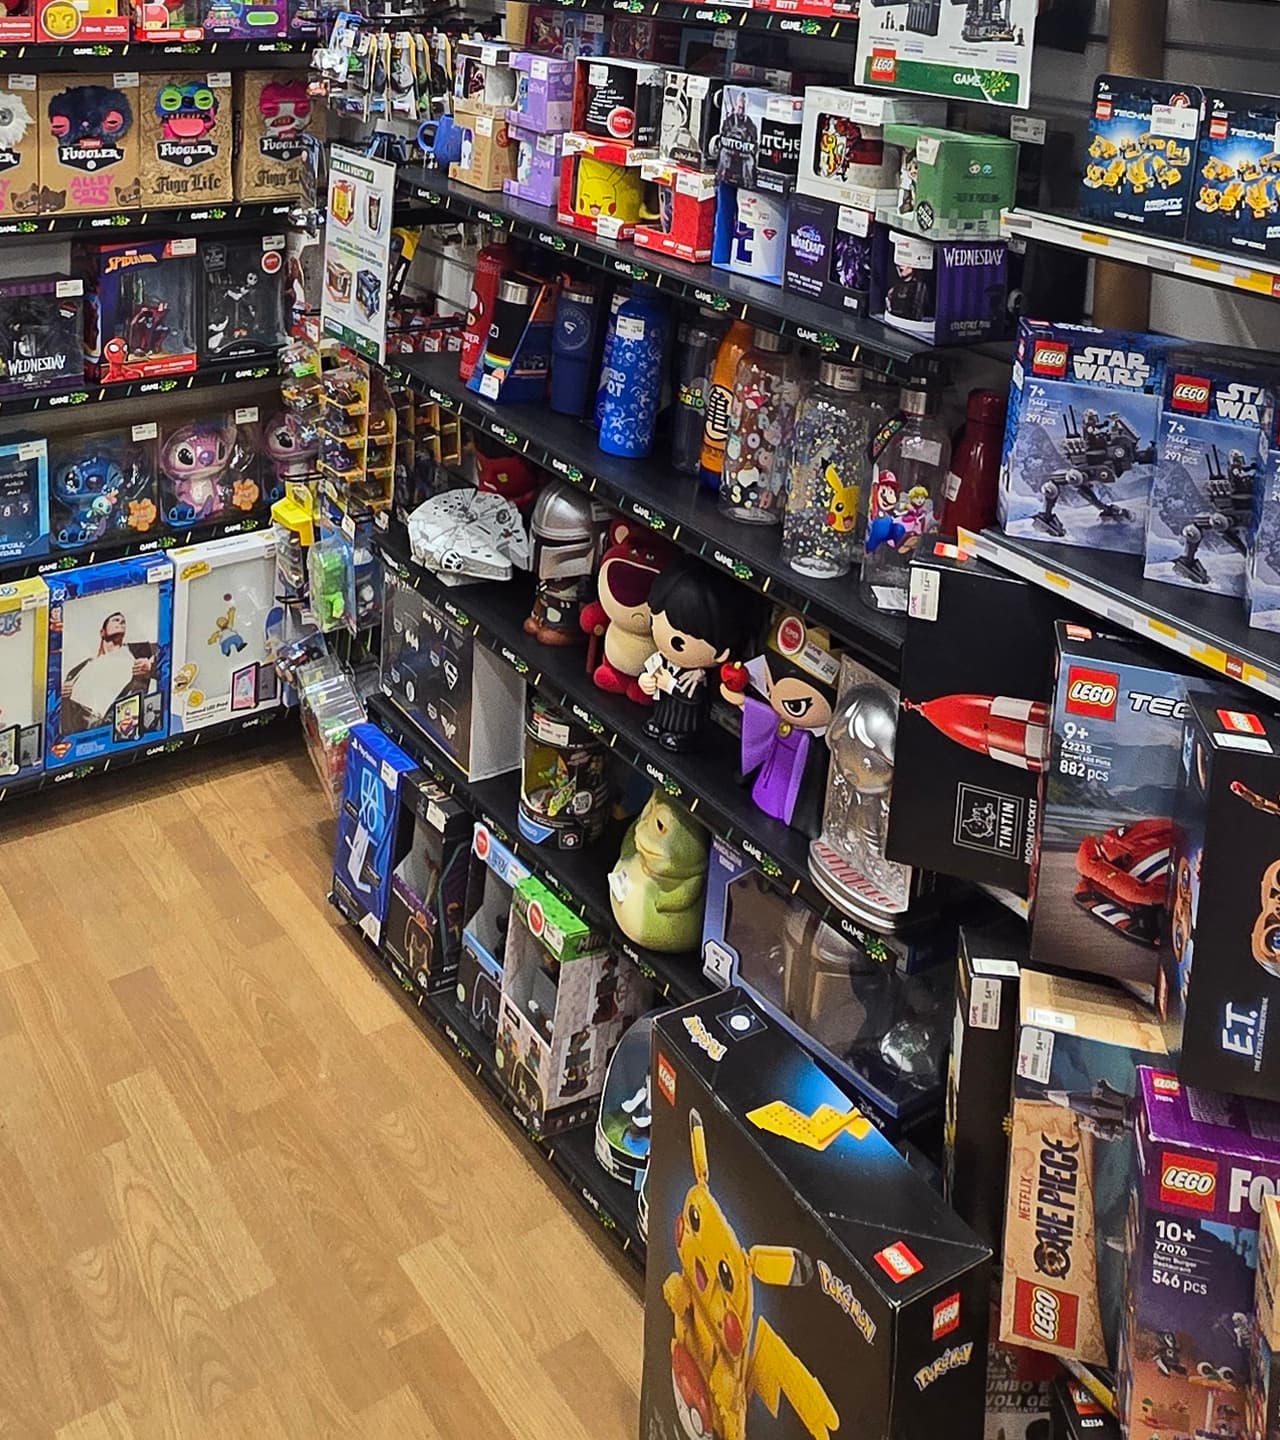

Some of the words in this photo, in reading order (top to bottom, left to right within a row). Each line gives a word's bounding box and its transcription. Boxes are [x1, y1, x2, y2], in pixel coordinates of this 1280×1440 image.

[776, 0, 798, 10] KITTY
[70, 174, 114, 191] ALLEY
[193, 173, 222, 191] Life
[942, 247, 1005, 268] WEDNESDAY
[8, 355, 66, 377] WEDNESDAY
[1034, 350, 1067, 367] LEGO
[1073, 346, 1146, 371] STAR
[1073, 363, 1150, 388] WARS
[1063, 722, 1089, 740] 9+
[1061, 741, 1093, 755] 42235
[1059, 761, 1085, 779] 882
[1086, 767, 1110, 782] pcs
[998, 802, 1015, 848] TINTIN
[1027, 798, 1037, 834] ROCKET
[1024, 835, 1034, 865] MOON
[1221, 1002, 1258, 1056] E.T.
[1017, 1175, 1034, 1222] NETFLIX
[1155, 1219, 1197, 1242] 10+
[1155, 1242, 1187, 1257] 77076
[1152, 1269, 1181, 1288] 546
[1183, 1280, 1208, 1296] pcs
[1030, 1286, 1059, 1340] LEGO
